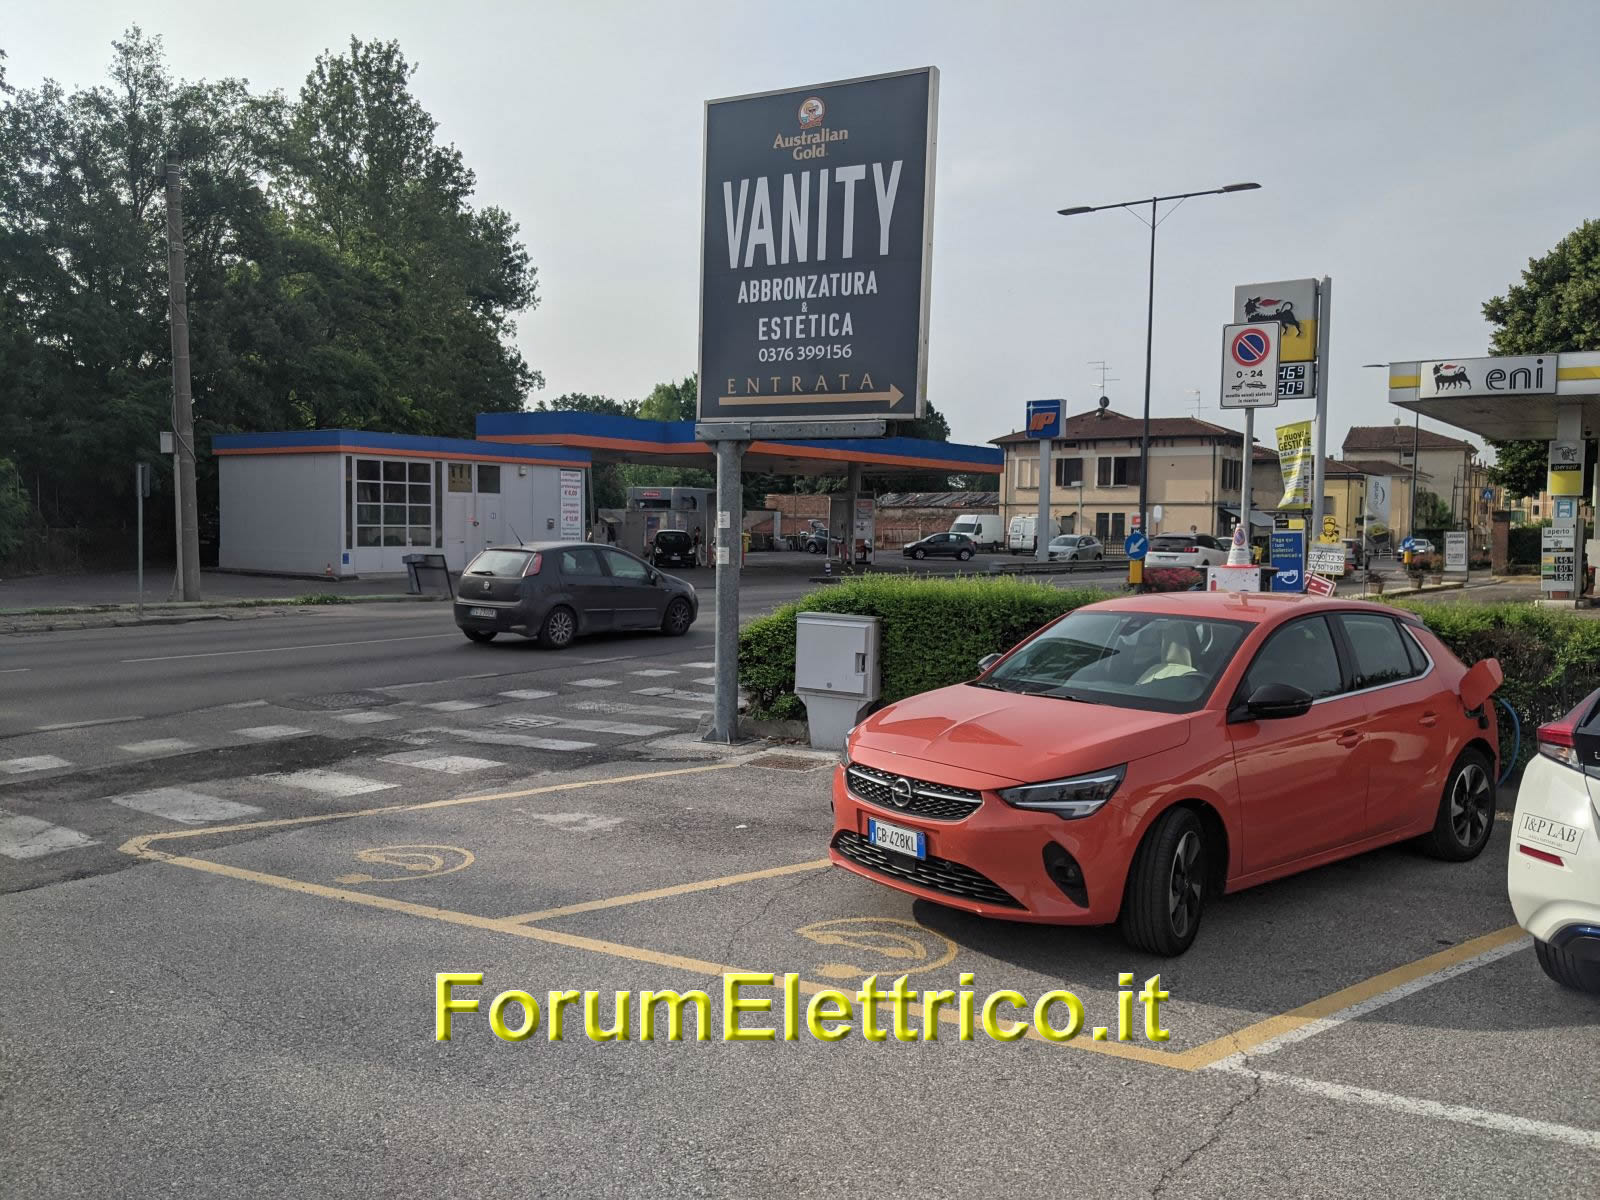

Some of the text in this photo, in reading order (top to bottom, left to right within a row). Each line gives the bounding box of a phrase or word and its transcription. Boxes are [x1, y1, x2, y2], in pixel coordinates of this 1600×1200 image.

[773, 128, 848, 149] Australian
[793, 143, 825, 160] Gold
[723, 160, 903, 269] VANITY
[738, 271, 878, 304] ABBRONZATURA
[801, 301, 808, 313] &
[758, 312, 854, 341] ESTETICA
[758, 343, 852, 362] 0376 399156
[727, 373, 874, 395] ENTRATA
[1485, 358, 1543, 391] eni
[876, 826, 917, 852] GB 428KL
[1524, 816, 1547, 833] I&P
[1546, 823, 1577, 843] LAB
